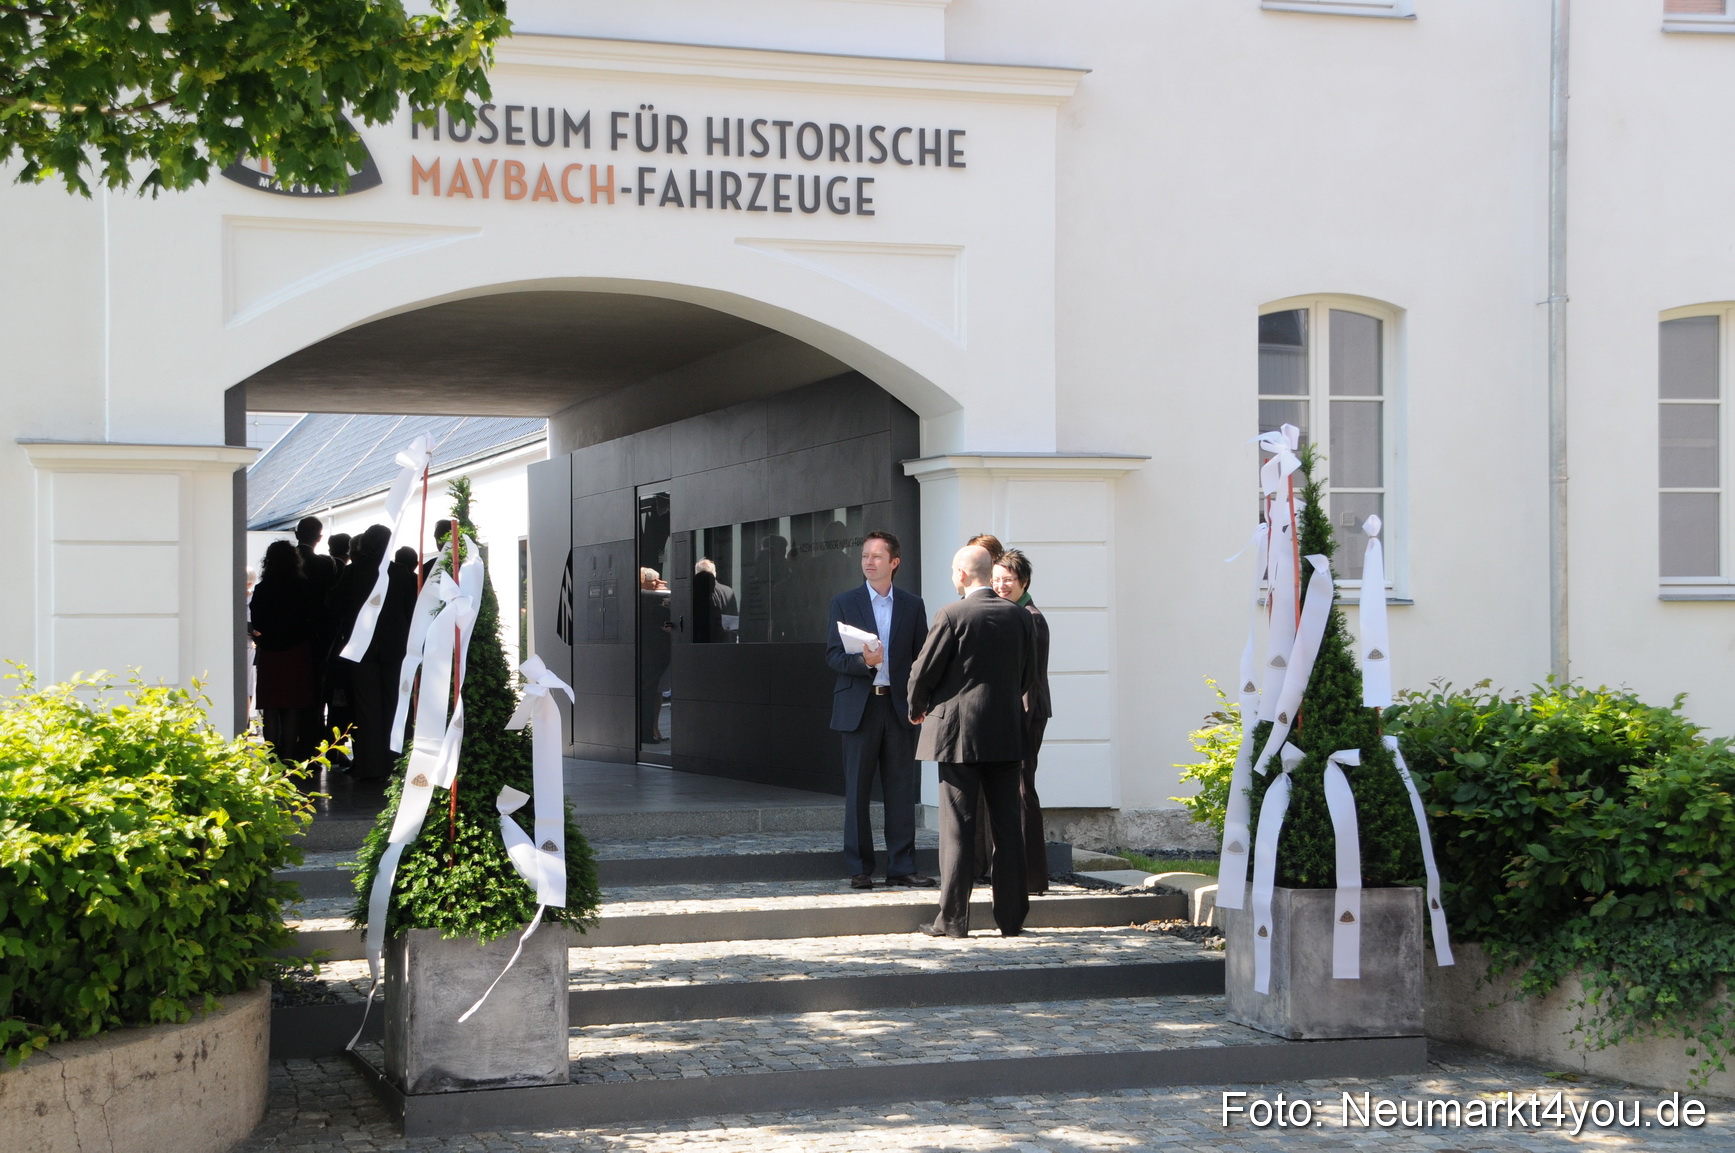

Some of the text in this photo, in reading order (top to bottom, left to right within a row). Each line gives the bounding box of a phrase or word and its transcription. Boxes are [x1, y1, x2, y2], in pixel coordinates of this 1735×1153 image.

[411, 103, 967, 168] MUSEUM FÜR HISTORISCHE
[411, 154, 876, 216] MAYBACH-FAHRZEUGE
